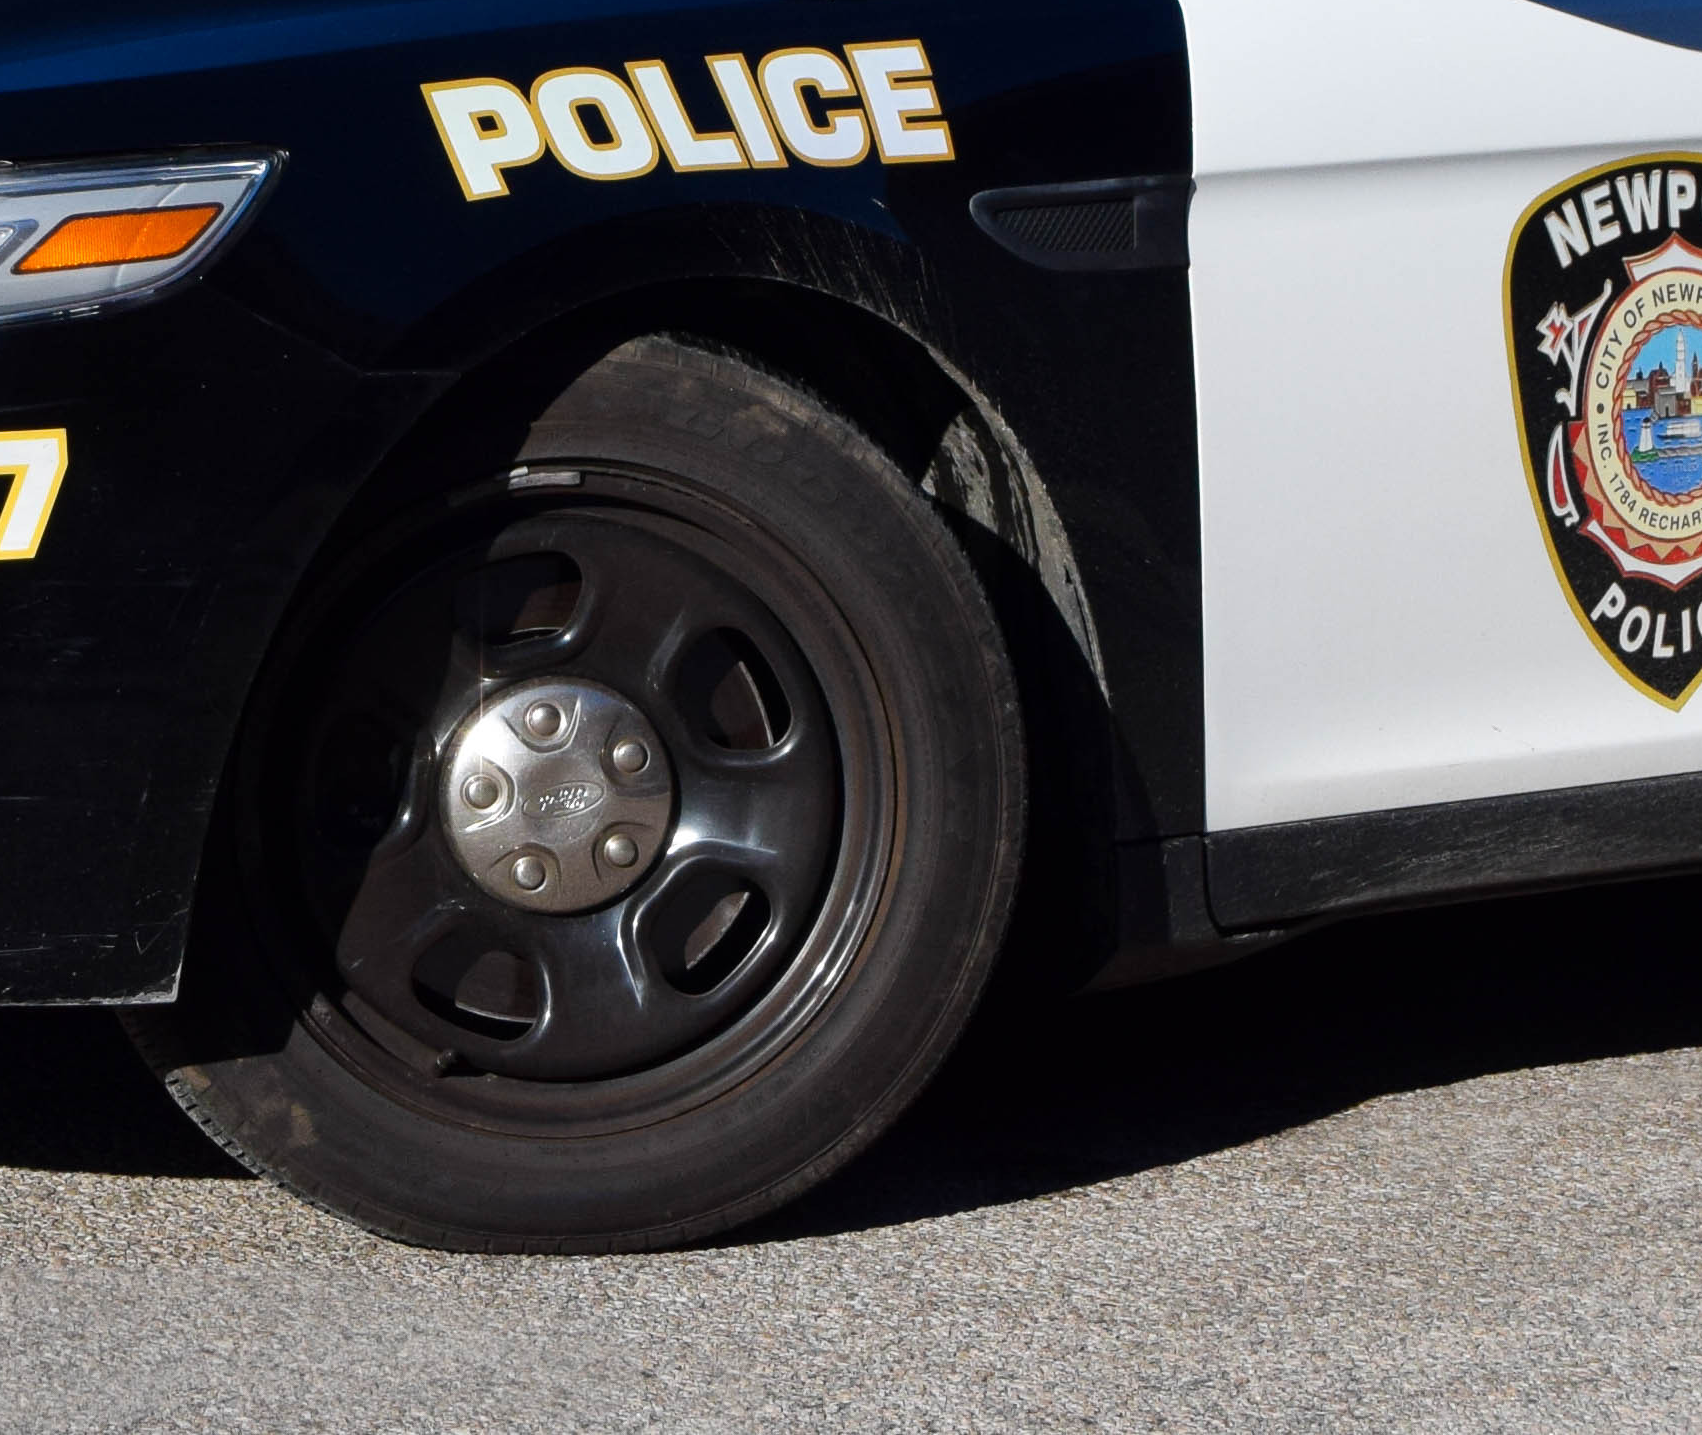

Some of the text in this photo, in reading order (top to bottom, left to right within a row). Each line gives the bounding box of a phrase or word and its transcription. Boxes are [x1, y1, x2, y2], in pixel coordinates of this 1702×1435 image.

[419, 38, 956, 201] POLICE
[1596, 330, 1623, 390] CITY
[1623, 297, 1646, 330] OF
[1609, 473, 1637, 513] 1784
